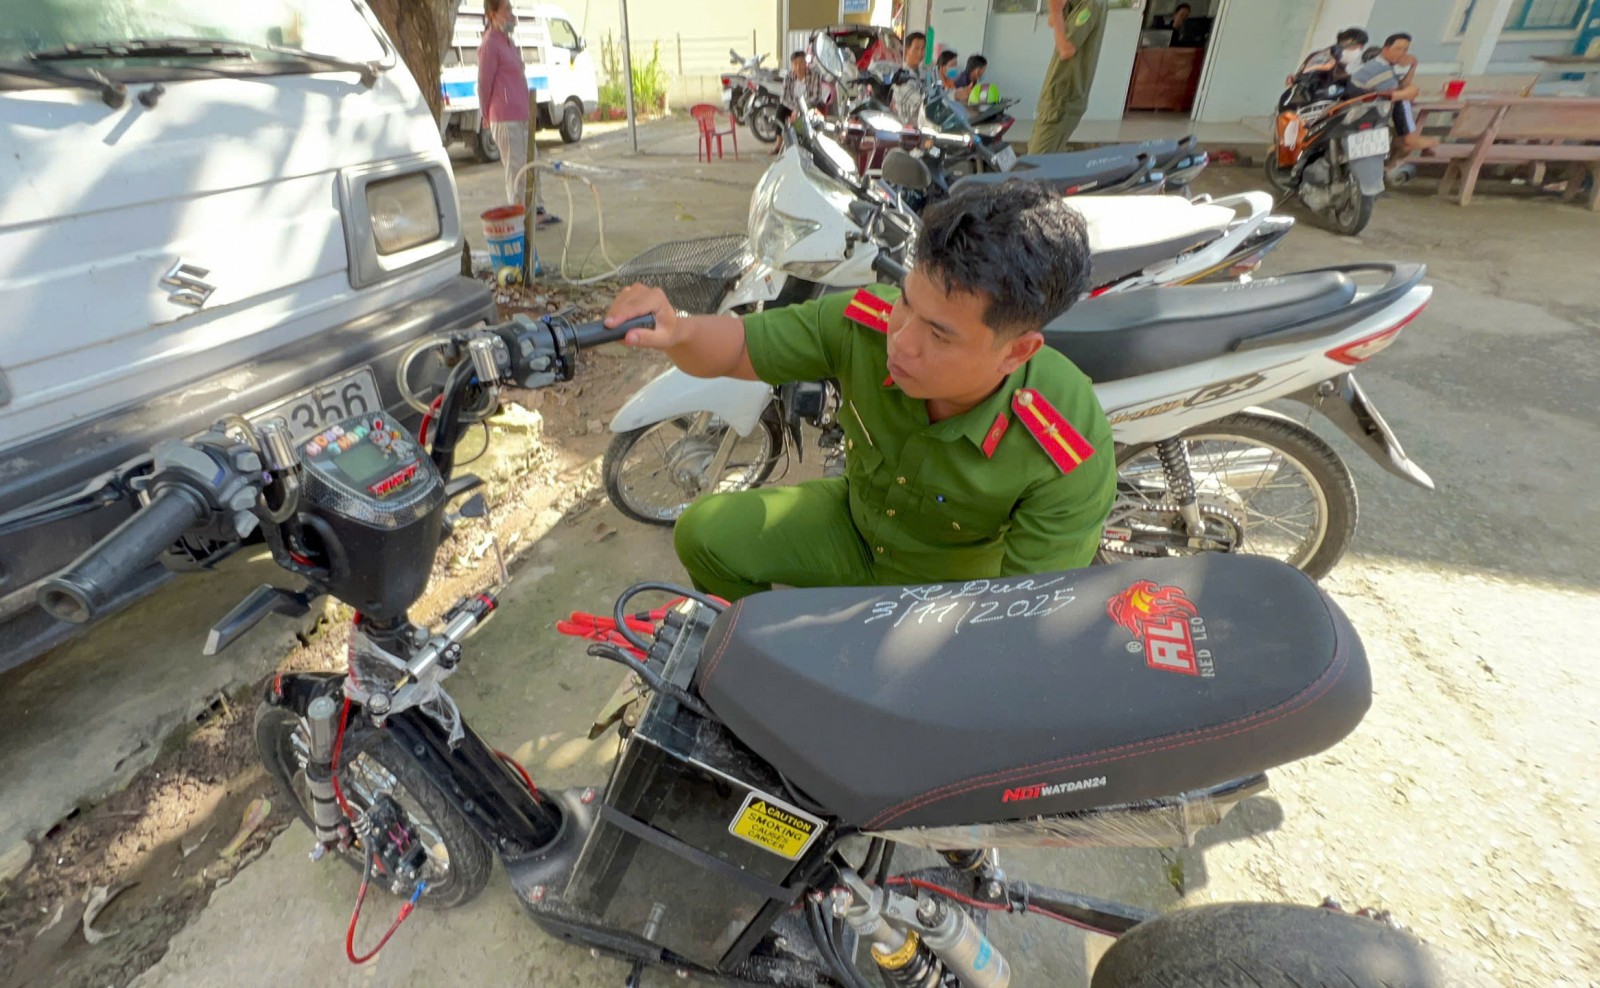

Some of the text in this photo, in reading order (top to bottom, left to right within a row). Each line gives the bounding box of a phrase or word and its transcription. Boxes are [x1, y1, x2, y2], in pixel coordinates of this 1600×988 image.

[1190, 616, 1208, 641] LEO
[748, 812, 803, 842] SMOKING
[767, 807, 812, 832] CAUTION
[748, 830, 785, 850] CANCER
[751, 824, 788, 844] CAUSES
